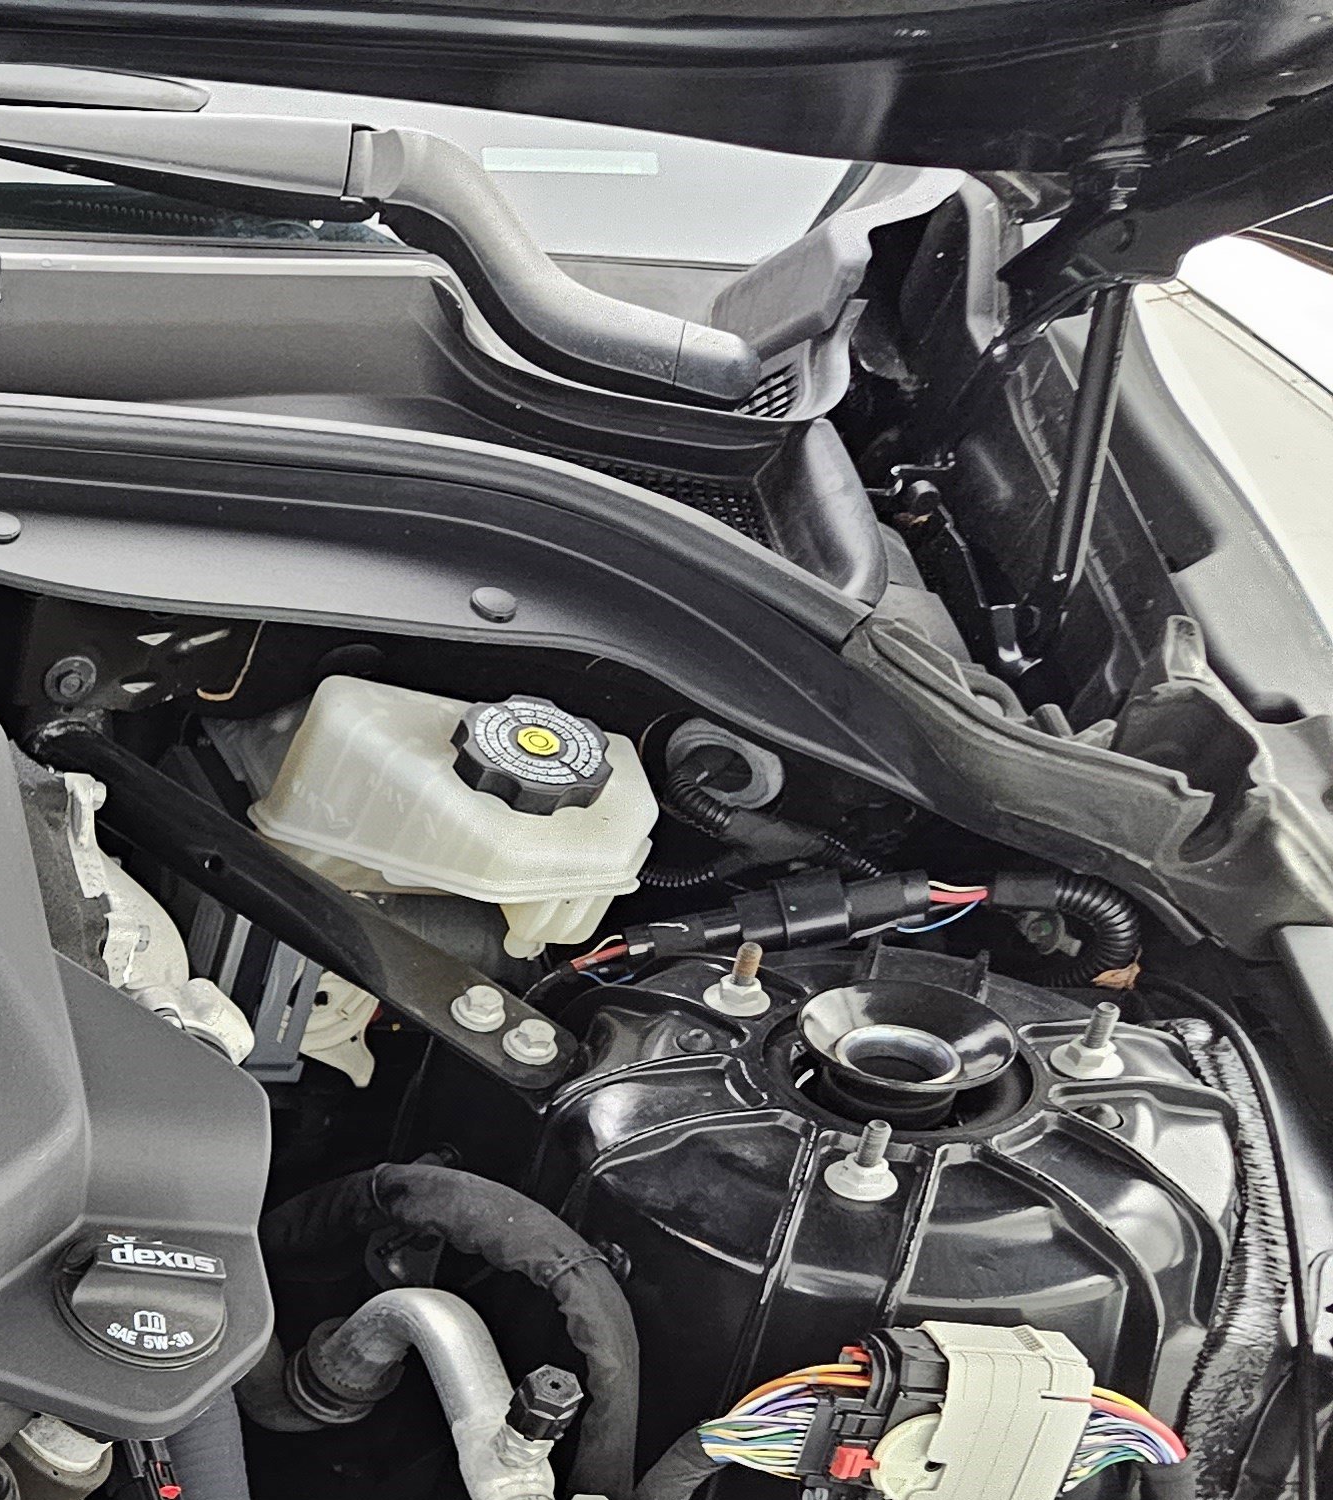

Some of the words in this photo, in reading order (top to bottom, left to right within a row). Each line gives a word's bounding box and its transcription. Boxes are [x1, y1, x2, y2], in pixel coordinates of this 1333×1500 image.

[111, 1243, 217, 1273] dexos
[107, 1322, 137, 1346] SAE
[143, 1331, 195, 1351] 5W-30
